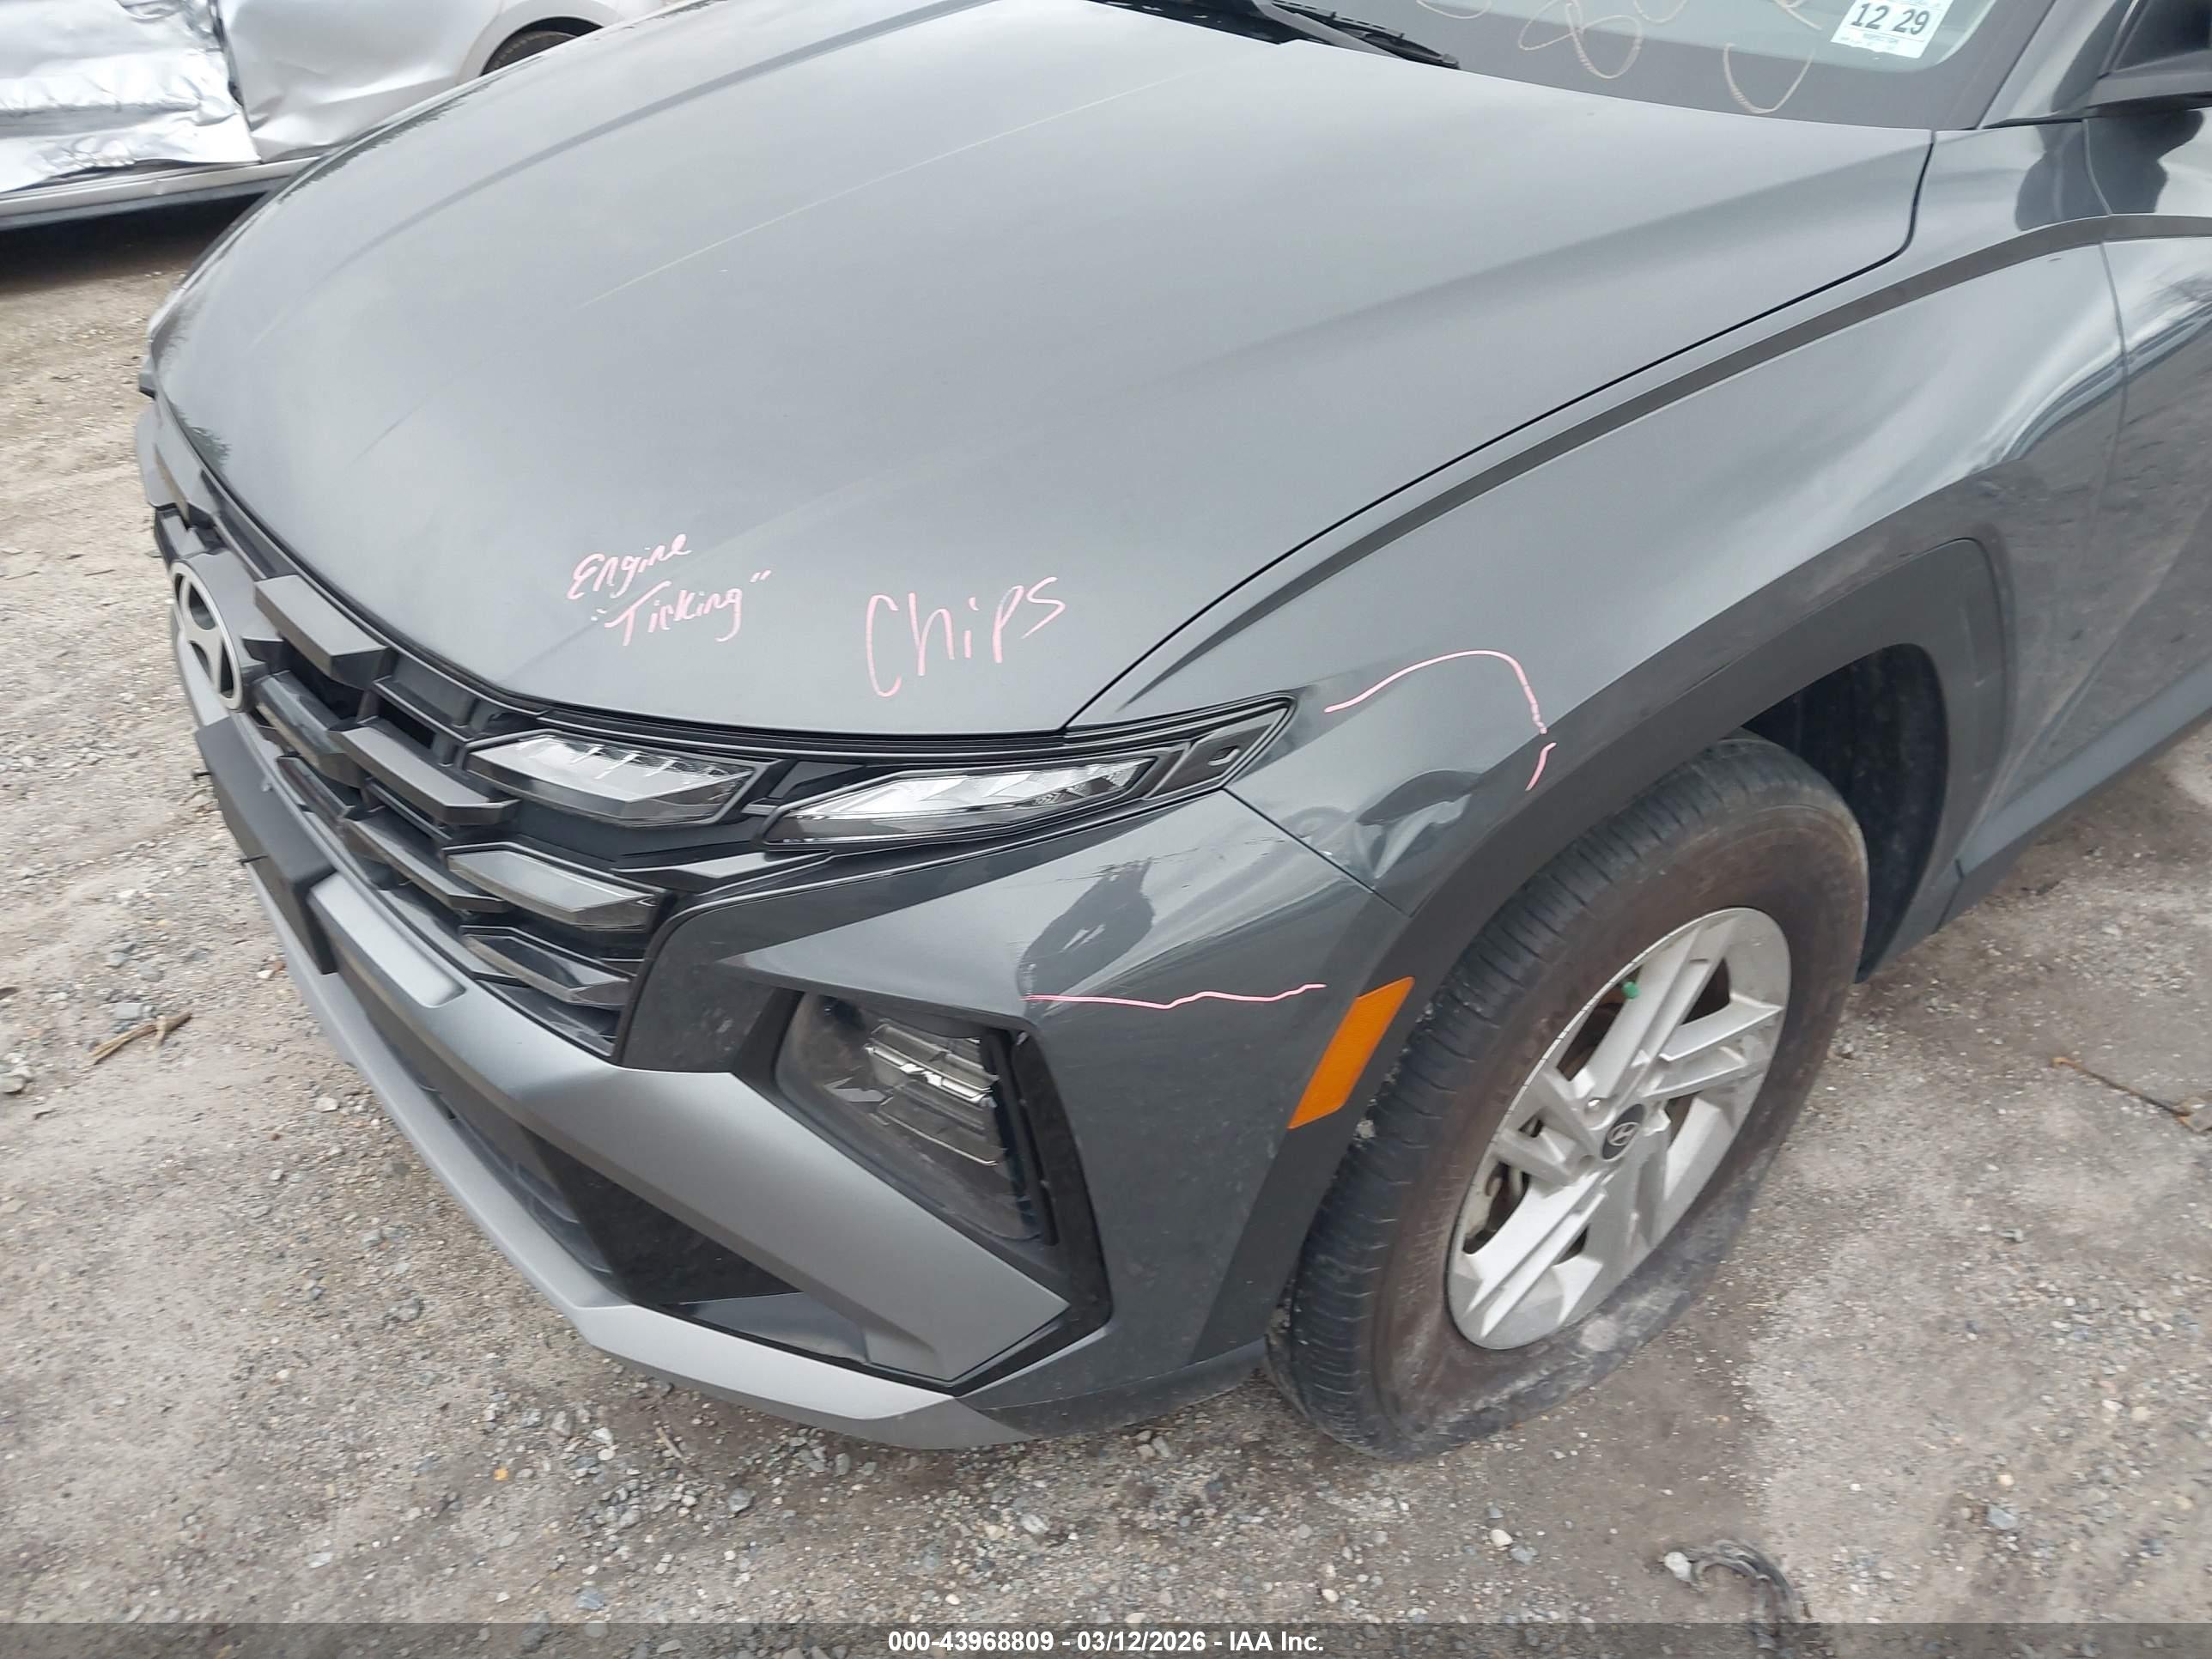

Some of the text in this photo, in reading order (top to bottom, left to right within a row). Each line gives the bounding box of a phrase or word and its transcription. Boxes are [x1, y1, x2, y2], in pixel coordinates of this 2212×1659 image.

[1850, 3, 1930, 35] 12 29
[566, 533, 692, 600] Engine
